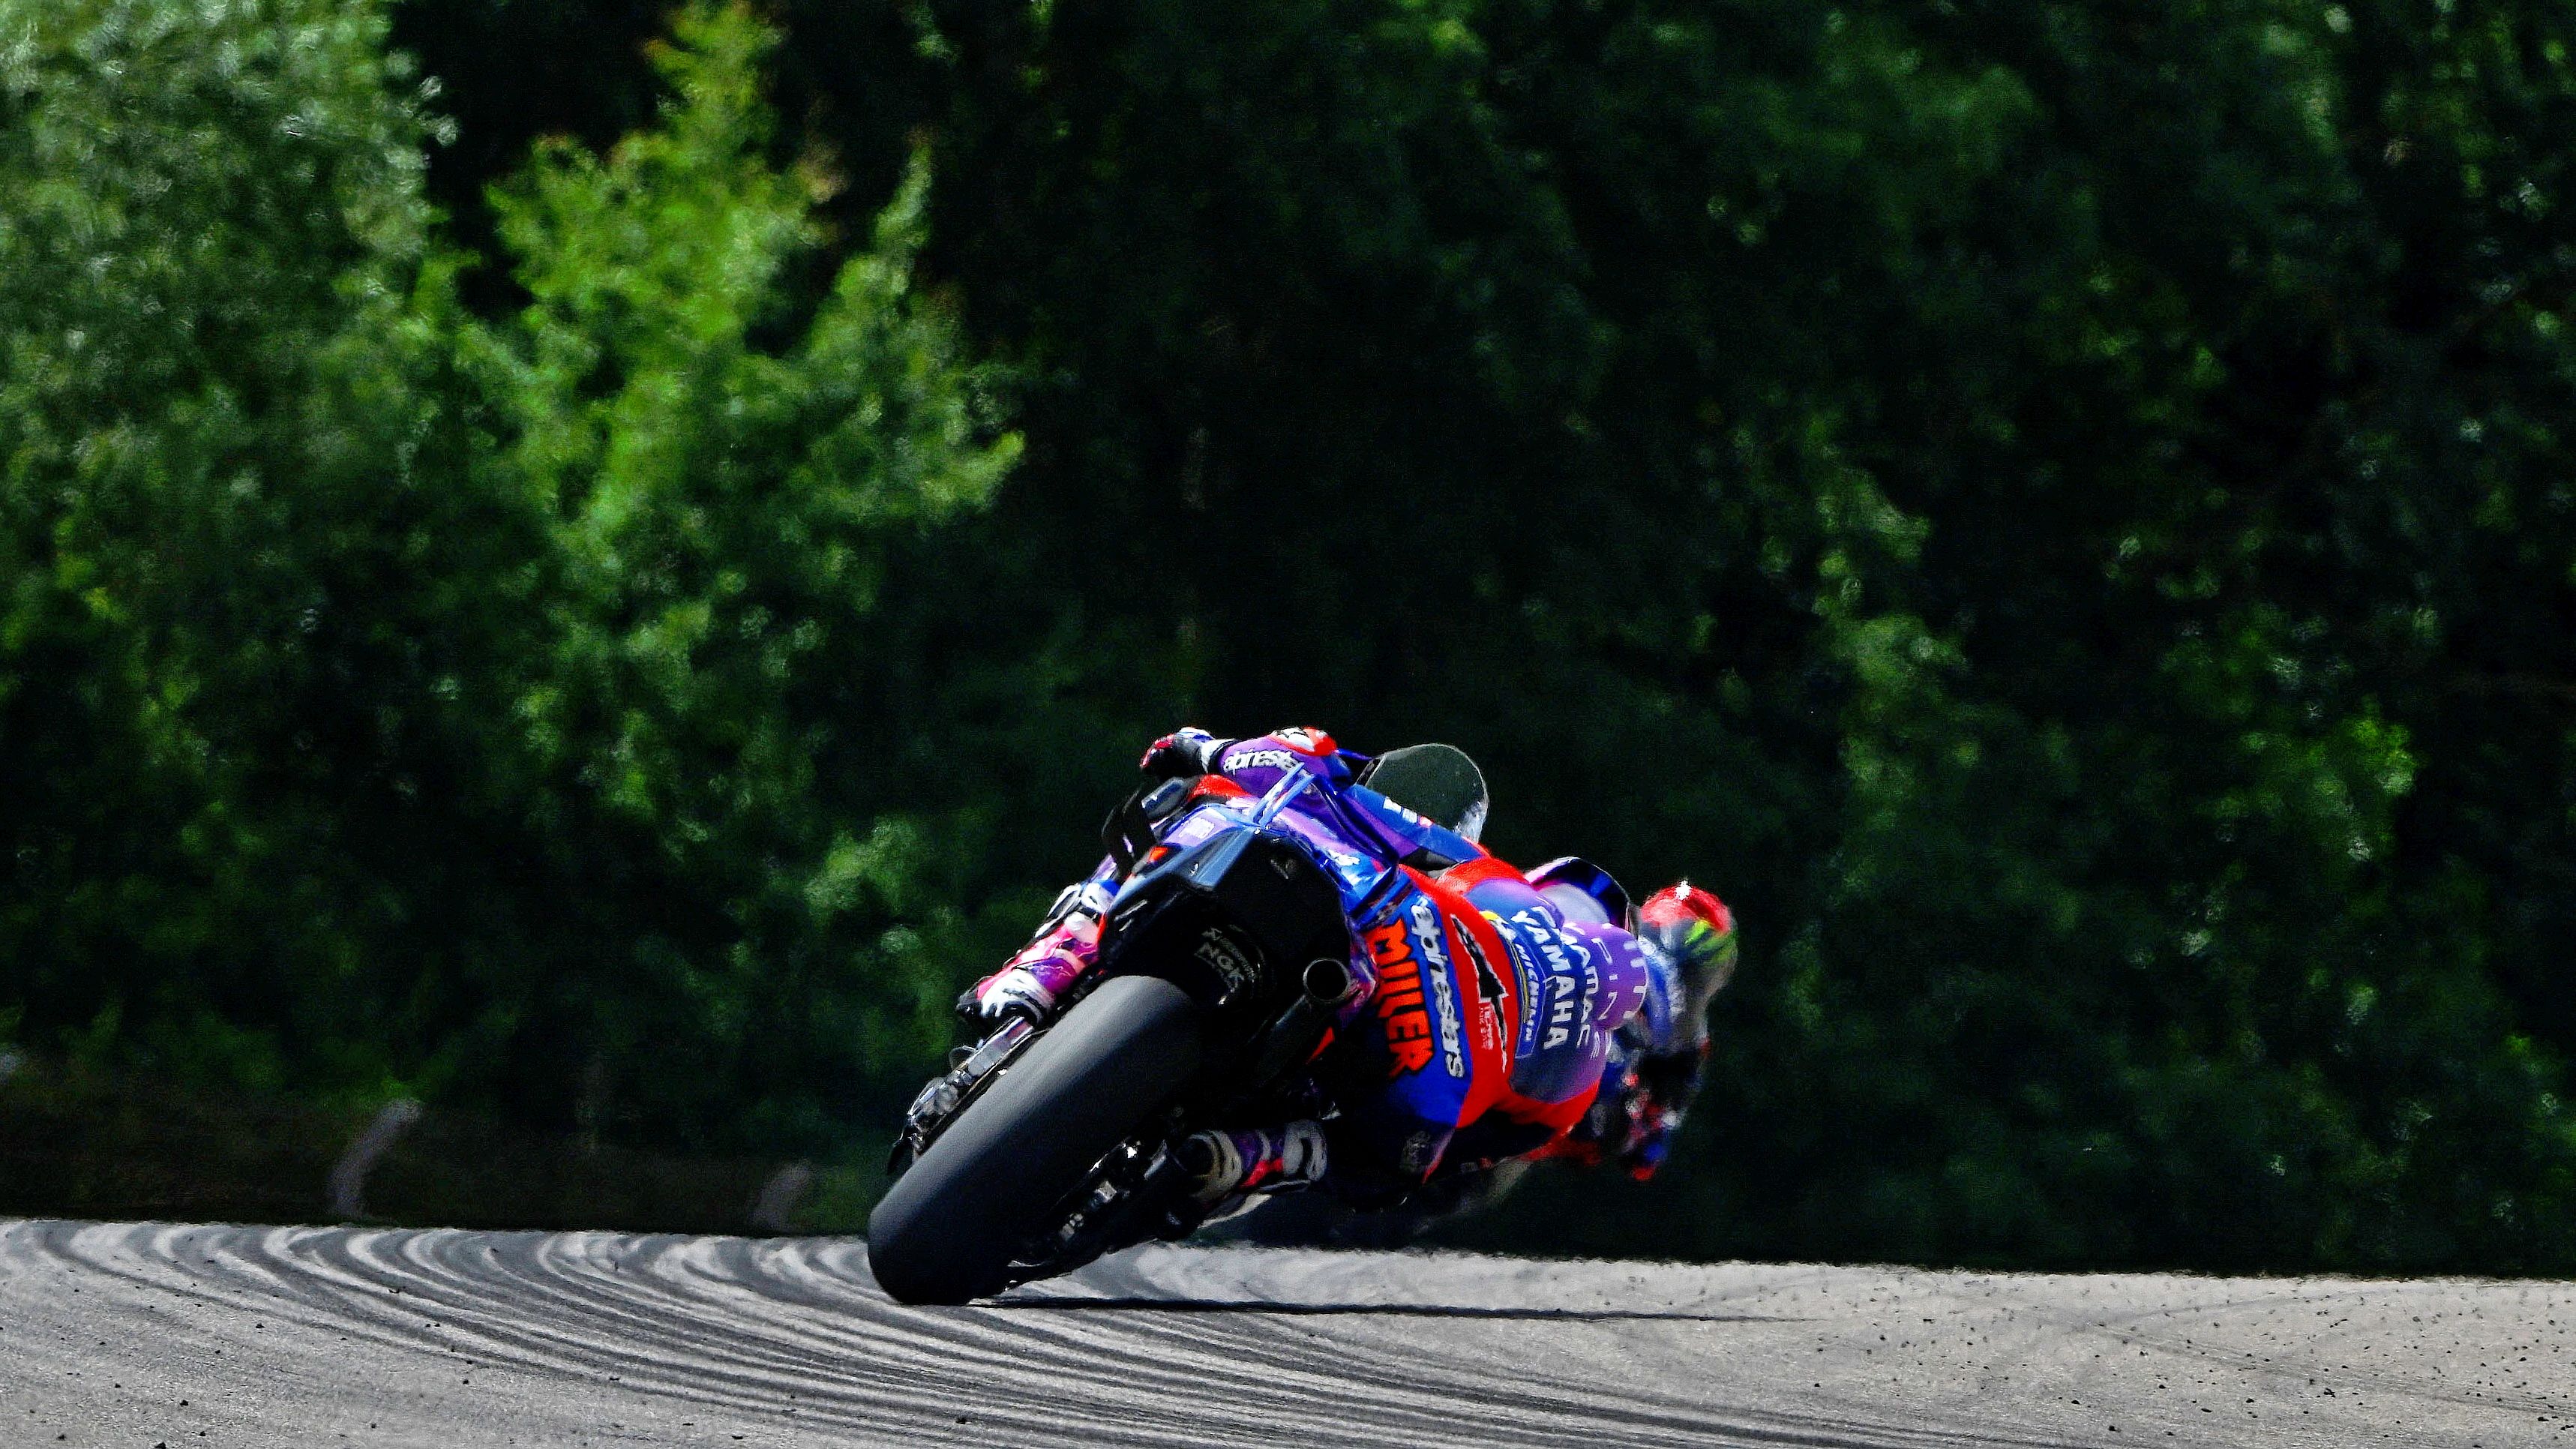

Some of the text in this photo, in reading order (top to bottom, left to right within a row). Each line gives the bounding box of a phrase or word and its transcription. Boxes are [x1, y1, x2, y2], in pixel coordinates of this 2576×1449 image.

[1223, 748, 1302, 775] alpinest
[1366, 919, 1434, 1077] MILLER
[1411, 903, 1465, 1078] alpinestars
[1511, 910, 1575, 1050] YAMAHA
[1516, 944, 1539, 1042] MICHELIN
